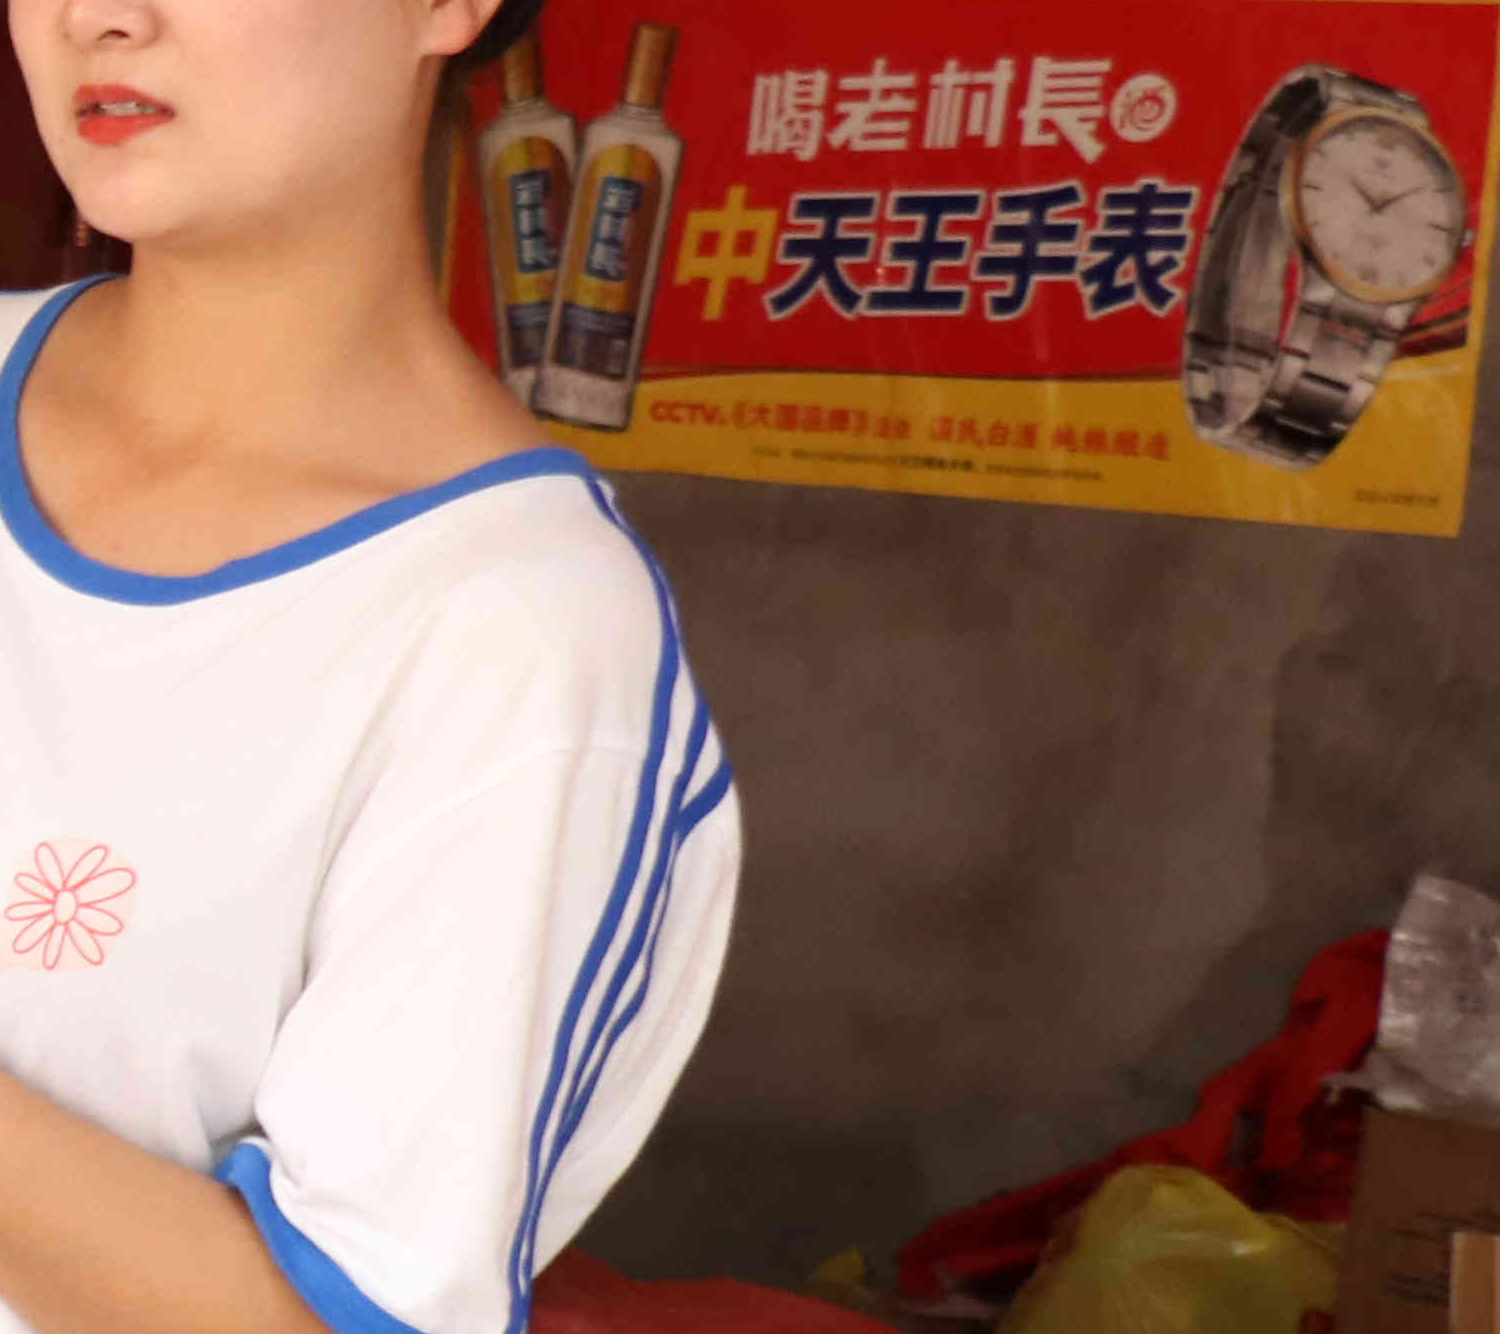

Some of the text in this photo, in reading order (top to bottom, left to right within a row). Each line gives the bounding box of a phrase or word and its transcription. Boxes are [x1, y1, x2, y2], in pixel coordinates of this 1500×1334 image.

[678, 179, 1204, 322] 中天王手表
